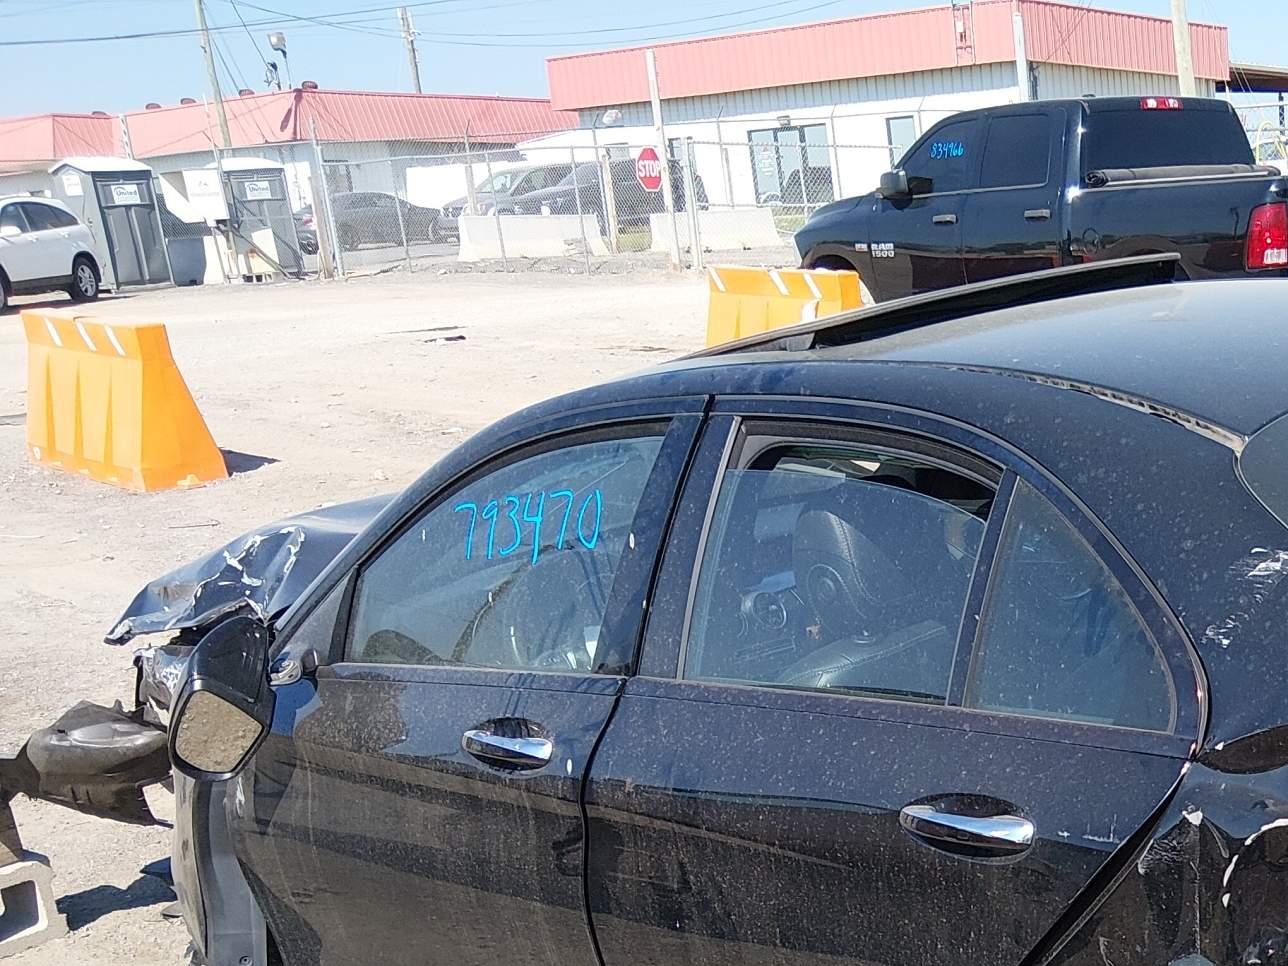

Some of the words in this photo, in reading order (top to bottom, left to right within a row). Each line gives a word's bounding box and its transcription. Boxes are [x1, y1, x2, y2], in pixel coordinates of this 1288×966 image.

[639, 160, 661, 177] STOP
[872, 250, 895, 258] 1500
[454, 489, 602, 565] 793470
